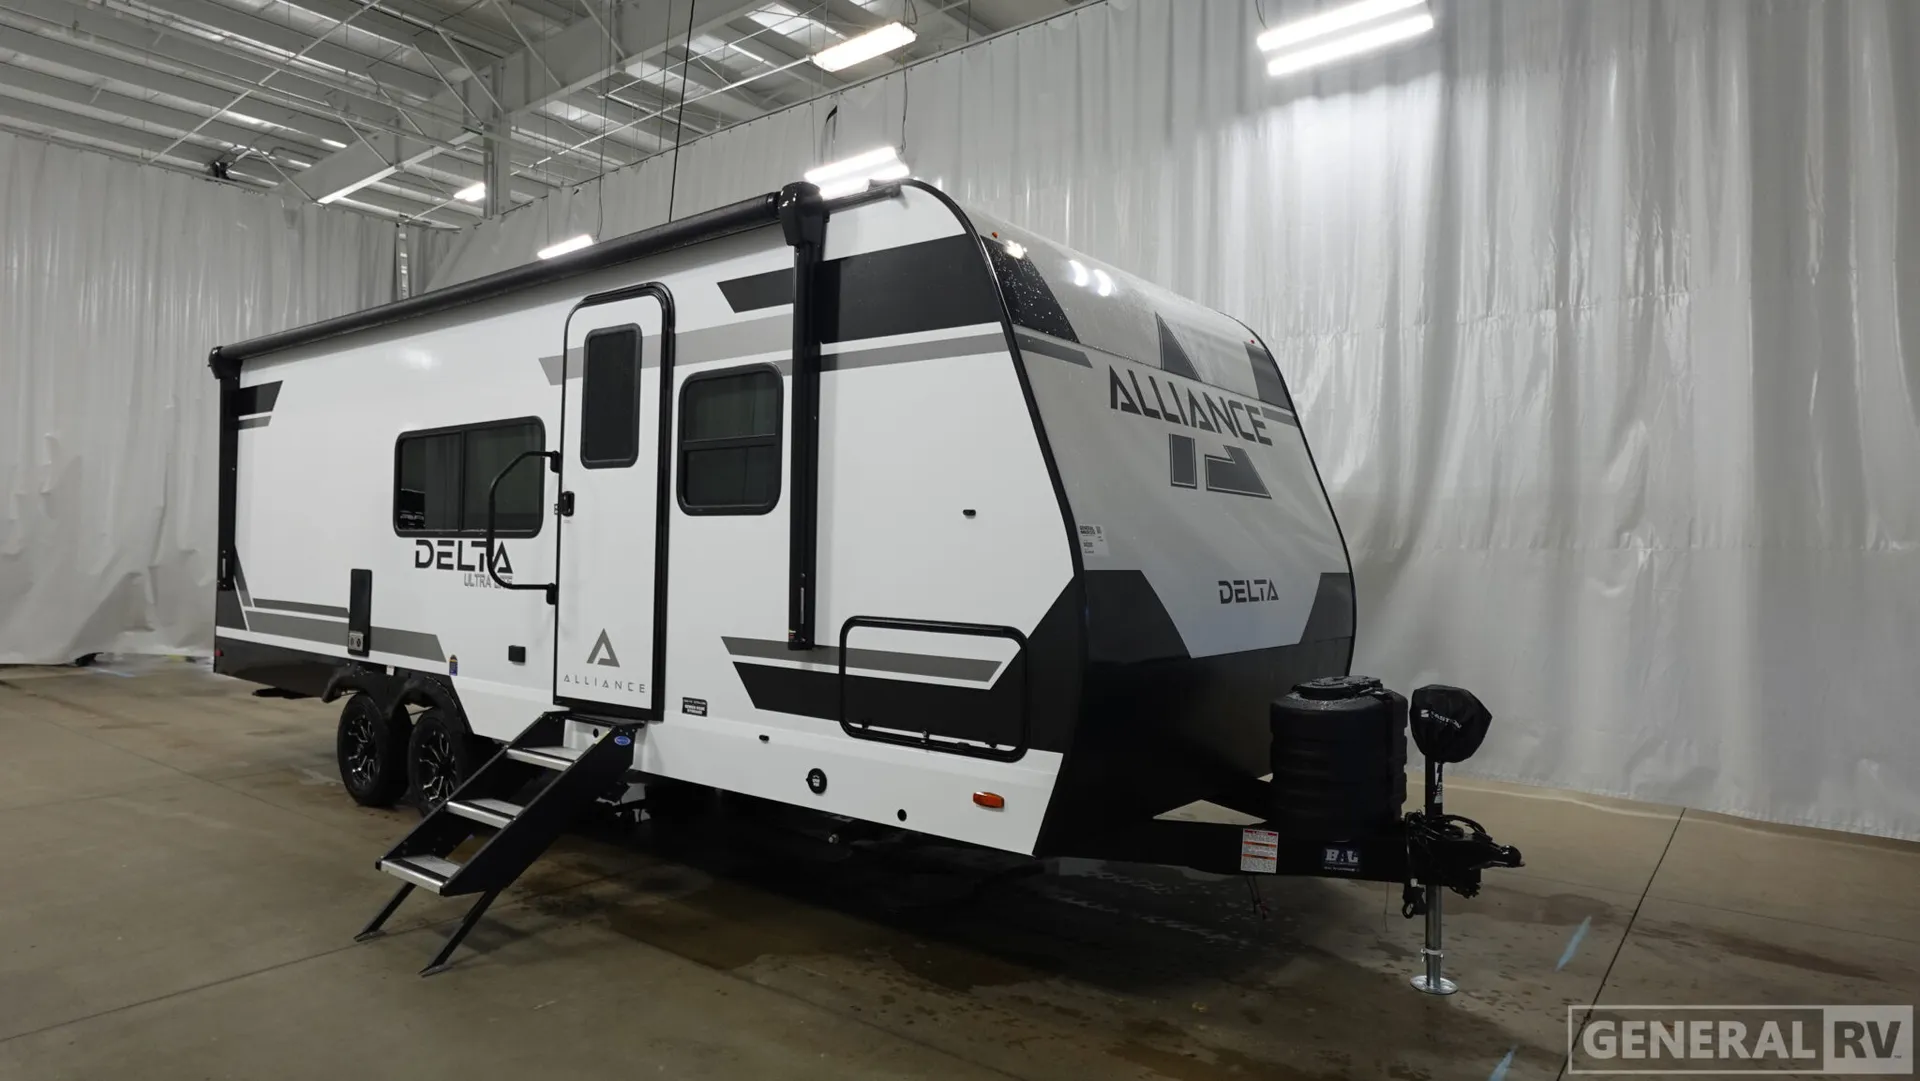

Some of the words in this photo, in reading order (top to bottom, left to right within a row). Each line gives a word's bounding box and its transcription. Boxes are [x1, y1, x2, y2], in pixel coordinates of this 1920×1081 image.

[1109, 364, 1273, 446] ALLIANCE
[415, 539, 513, 574] DELTA
[464, 573, 491, 588] ULTRA
[494, 574, 513, 589] LTE
[1218, 578, 1279, 604] DELTA
[563, 674, 646, 693] ALLIANCE
